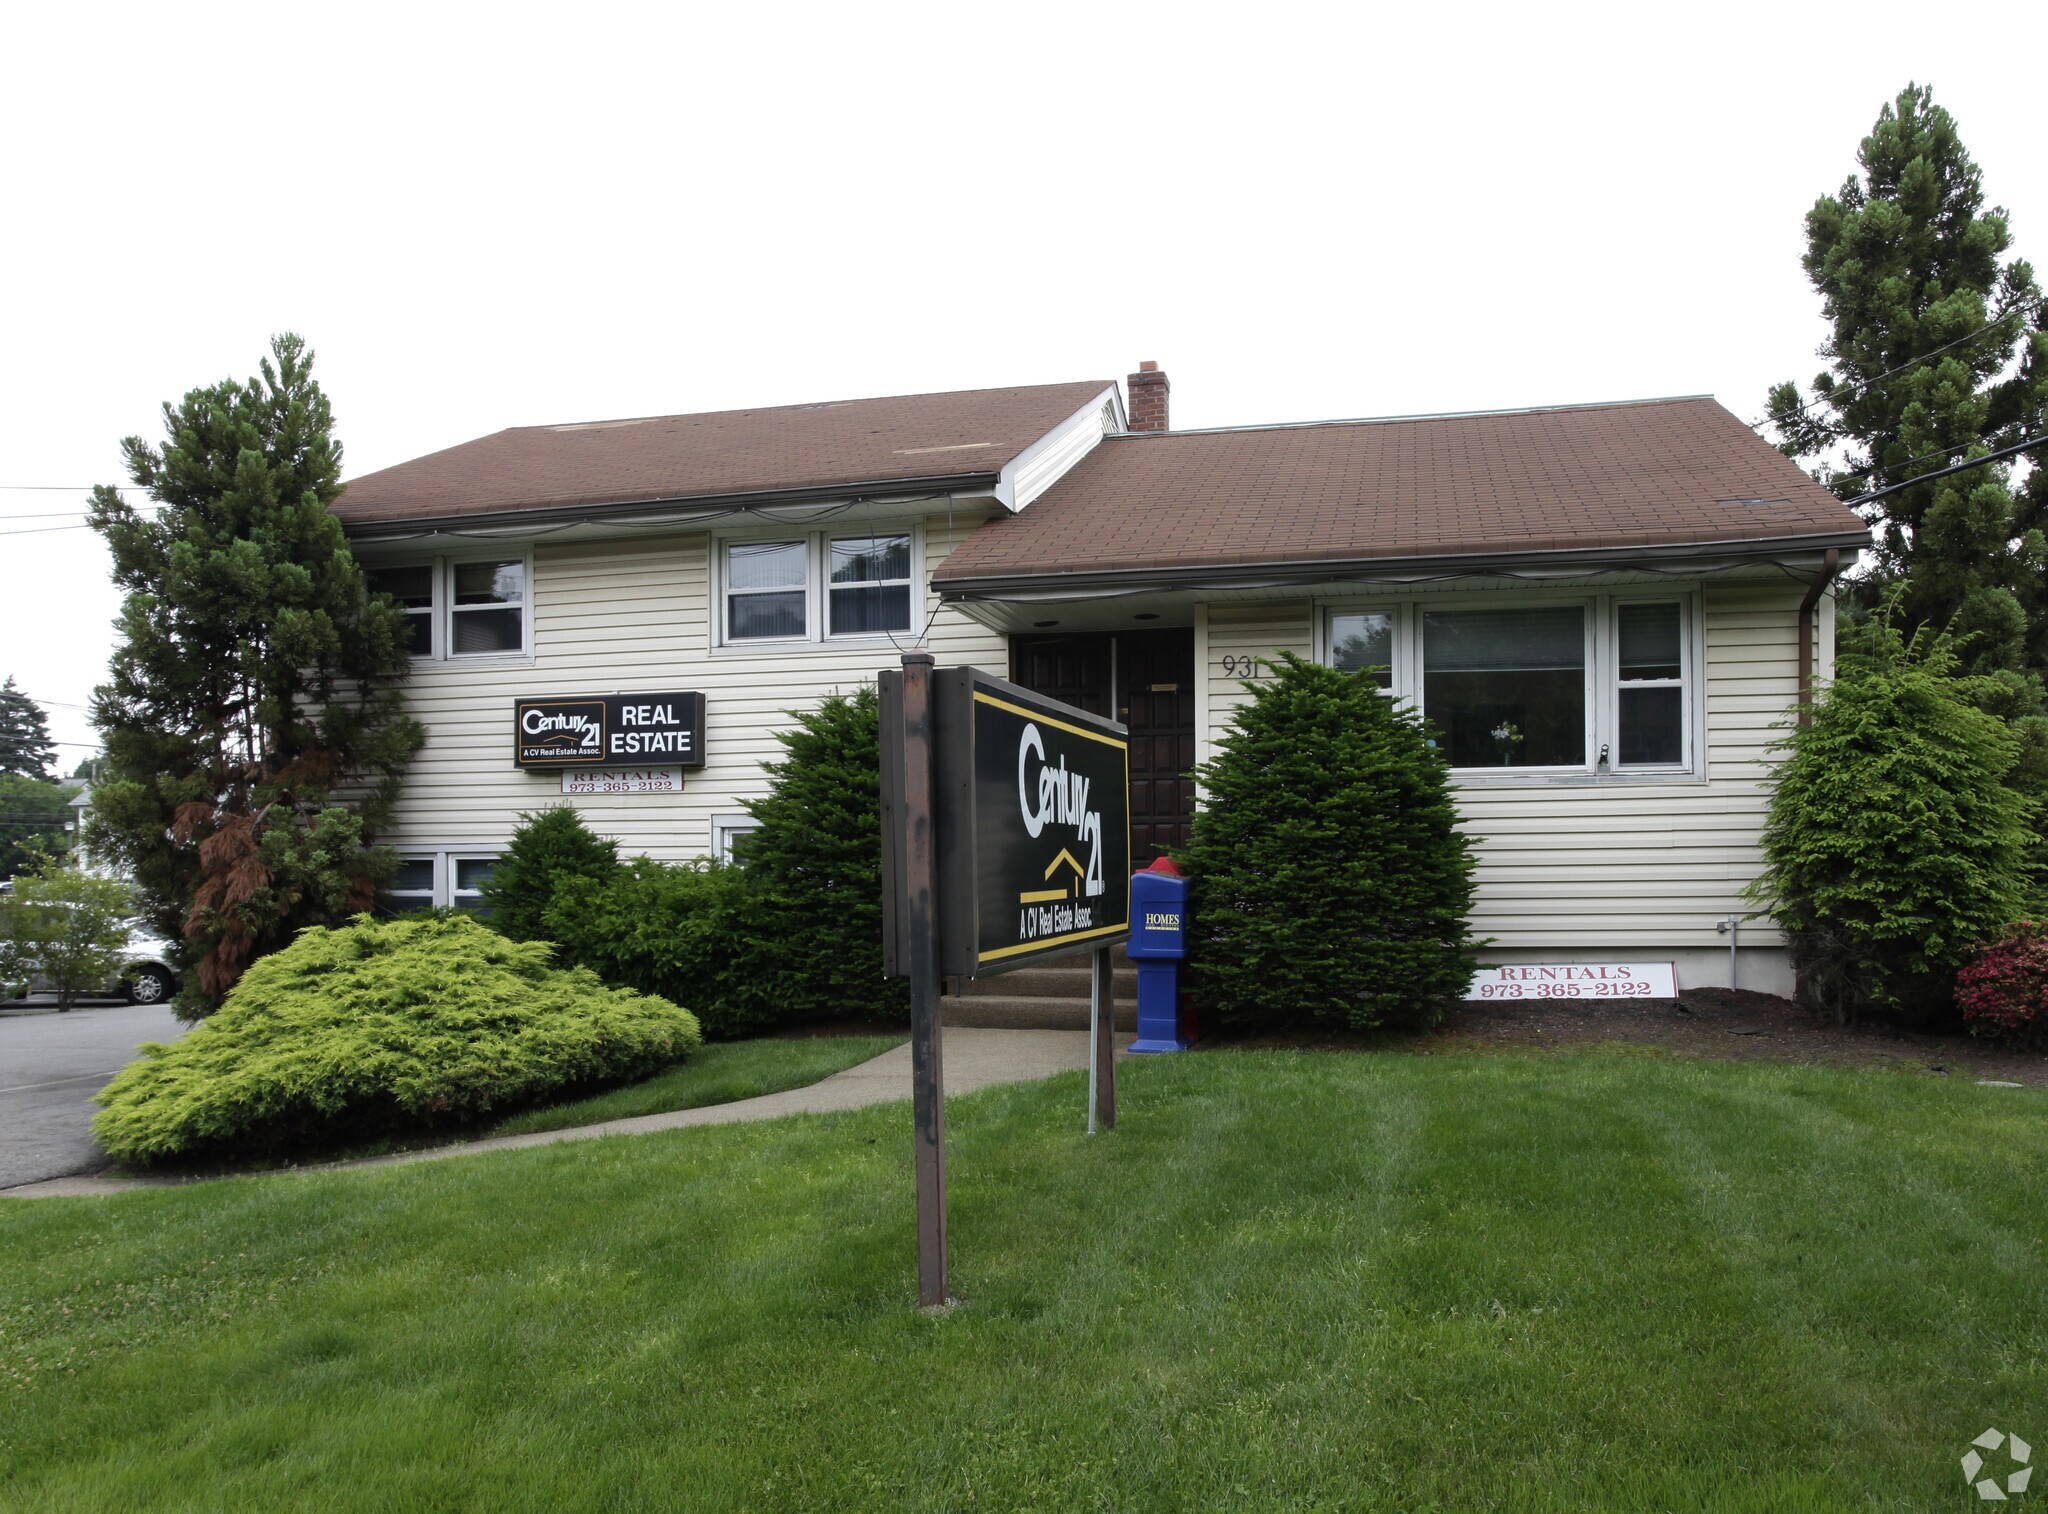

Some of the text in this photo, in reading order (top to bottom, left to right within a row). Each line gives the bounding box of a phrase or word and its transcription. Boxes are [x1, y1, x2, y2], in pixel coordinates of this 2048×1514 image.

[1223, 655, 1258, 679] 931
[522, 709, 588, 735] Century
[622, 704, 680, 726] REAL
[581, 722, 600, 747] 21
[611, 731, 691, 753] ESTATE
[523, 749, 529, 757] A
[529, 748, 540, 757] CV
[540, 748, 555, 756] Real
[556, 747, 578, 756] Estate
[578, 747, 601, 755] Assoc.
[569, 781, 673, 793] 973-365-2122
[573, 770, 670, 782] RENTALS
[1018, 722, 1090, 841] Century
[1084, 810, 1103, 897] 21
[1020, 902, 1093, 939] A CV Real Estate Assoc.
[1145, 913, 1180, 925] HOMES
[1499, 966, 1632, 981] RENTALS
[1480, 981, 1652, 998] 973-365-2122
